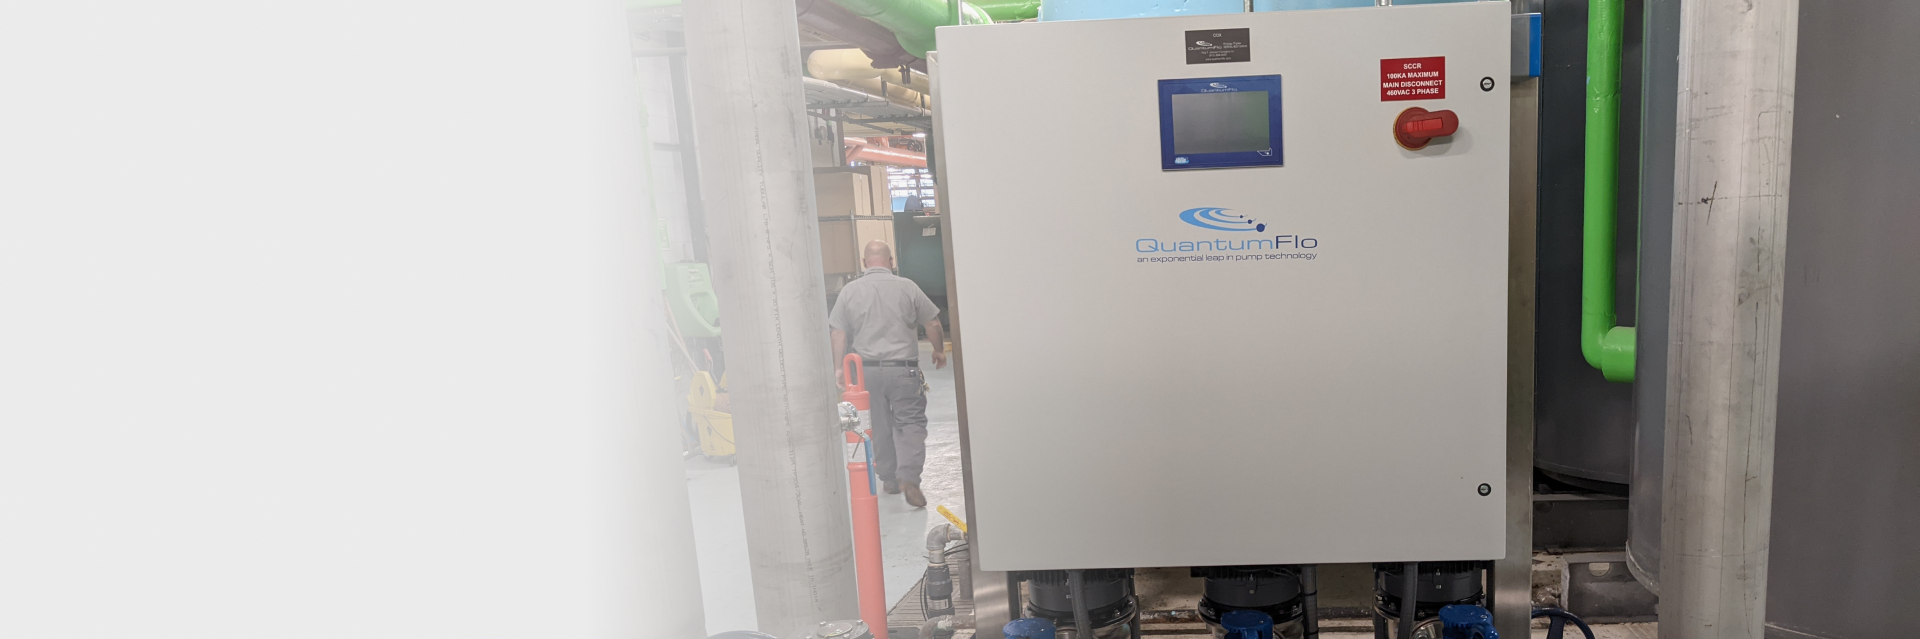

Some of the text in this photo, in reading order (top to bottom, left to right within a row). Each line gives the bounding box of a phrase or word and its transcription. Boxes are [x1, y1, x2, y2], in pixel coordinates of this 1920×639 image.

[1136, 235, 1318, 252] QuantumFlo
[1150, 254, 1204, 263] exponential
[1205, 254, 1224, 262] leap
[1265, 252, 1317, 261] technology
